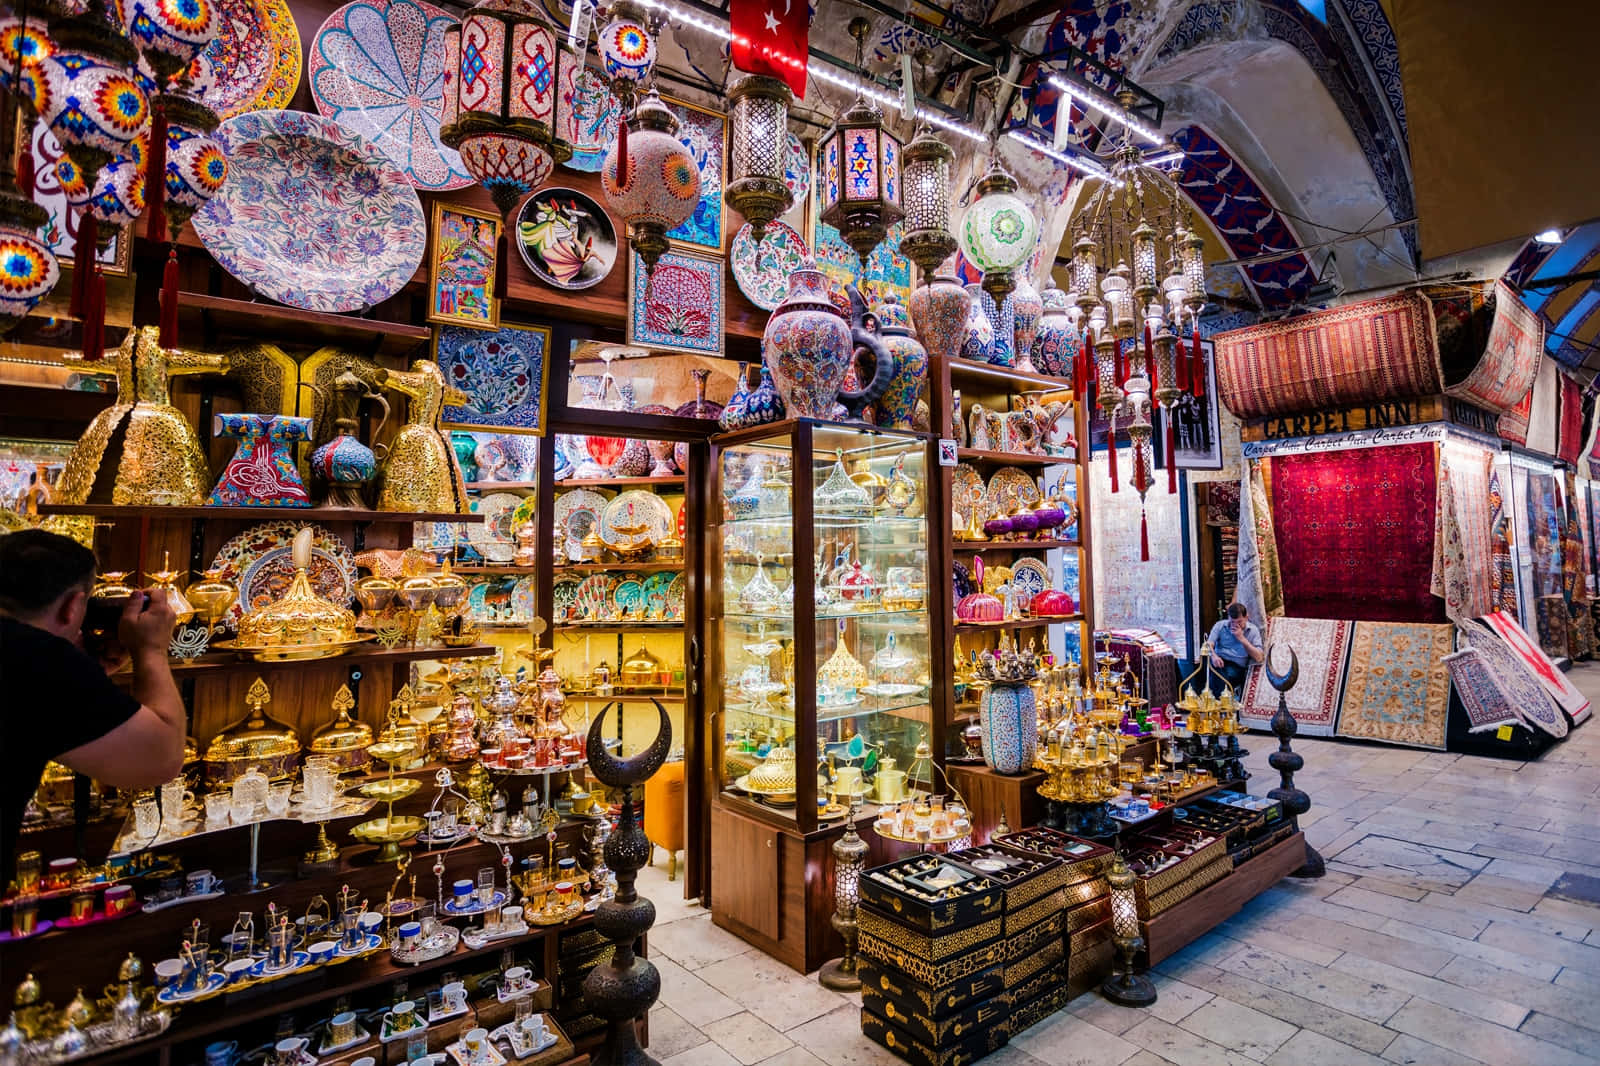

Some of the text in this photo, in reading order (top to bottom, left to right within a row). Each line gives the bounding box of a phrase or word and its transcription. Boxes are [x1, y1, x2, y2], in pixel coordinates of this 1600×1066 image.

[1263, 400, 1412, 438] CARPET INN
[1244, 443, 1279, 457] Carpet
[1305, 436, 1343, 451] Carpet
[1347, 433, 1367, 446] Inn
[1373, 429, 1416, 444] Carpet
[1420, 425, 1442, 438] Inn
